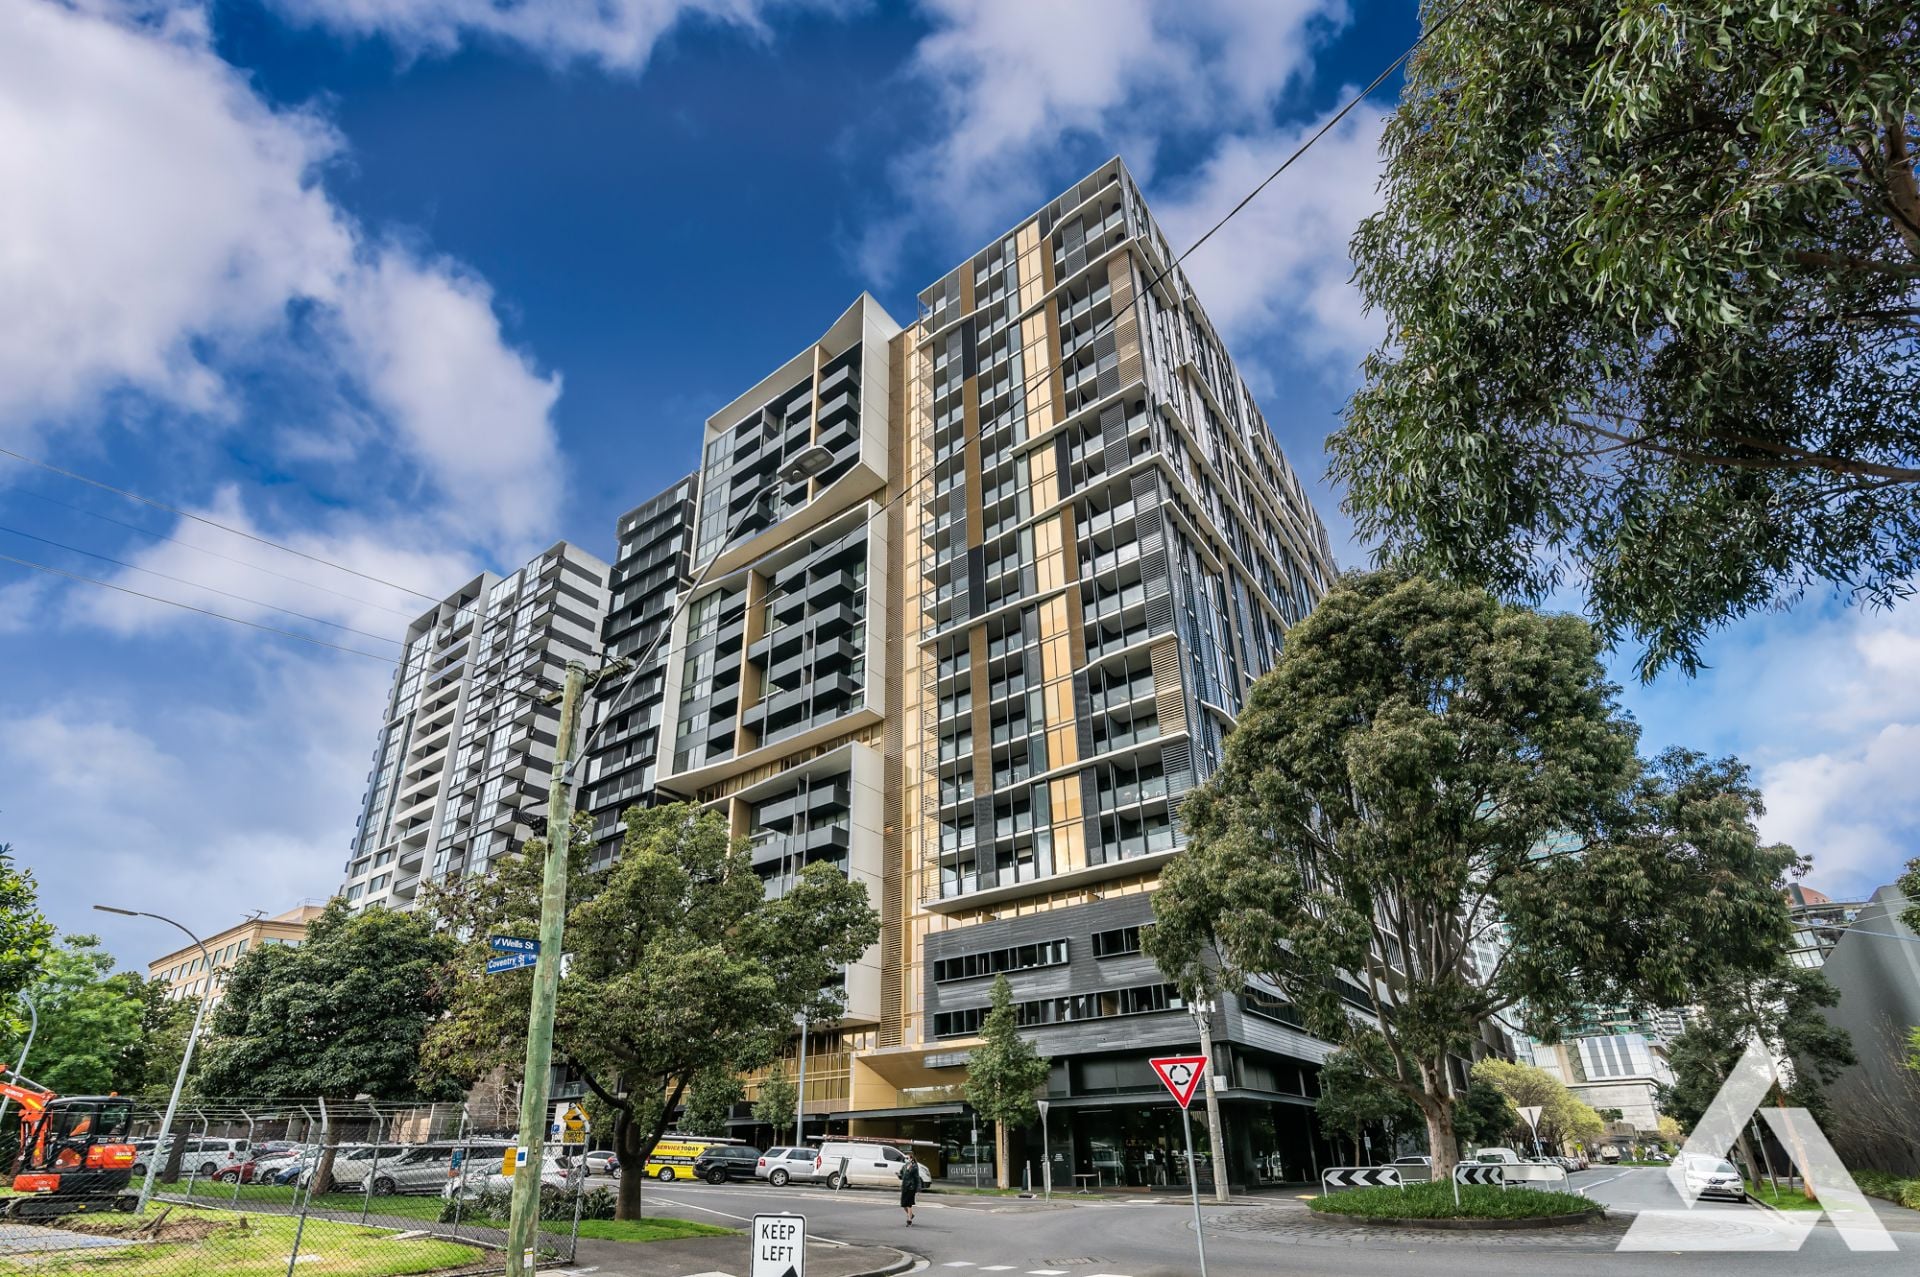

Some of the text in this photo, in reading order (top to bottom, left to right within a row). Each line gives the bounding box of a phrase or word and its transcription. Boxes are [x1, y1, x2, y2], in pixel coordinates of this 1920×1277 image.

[502, 938, 534, 950] Wells St
[488, 957, 516, 969] Coventry
[761, 1223, 796, 1241] KEEP
[762, 1244, 794, 1262] LEFT
